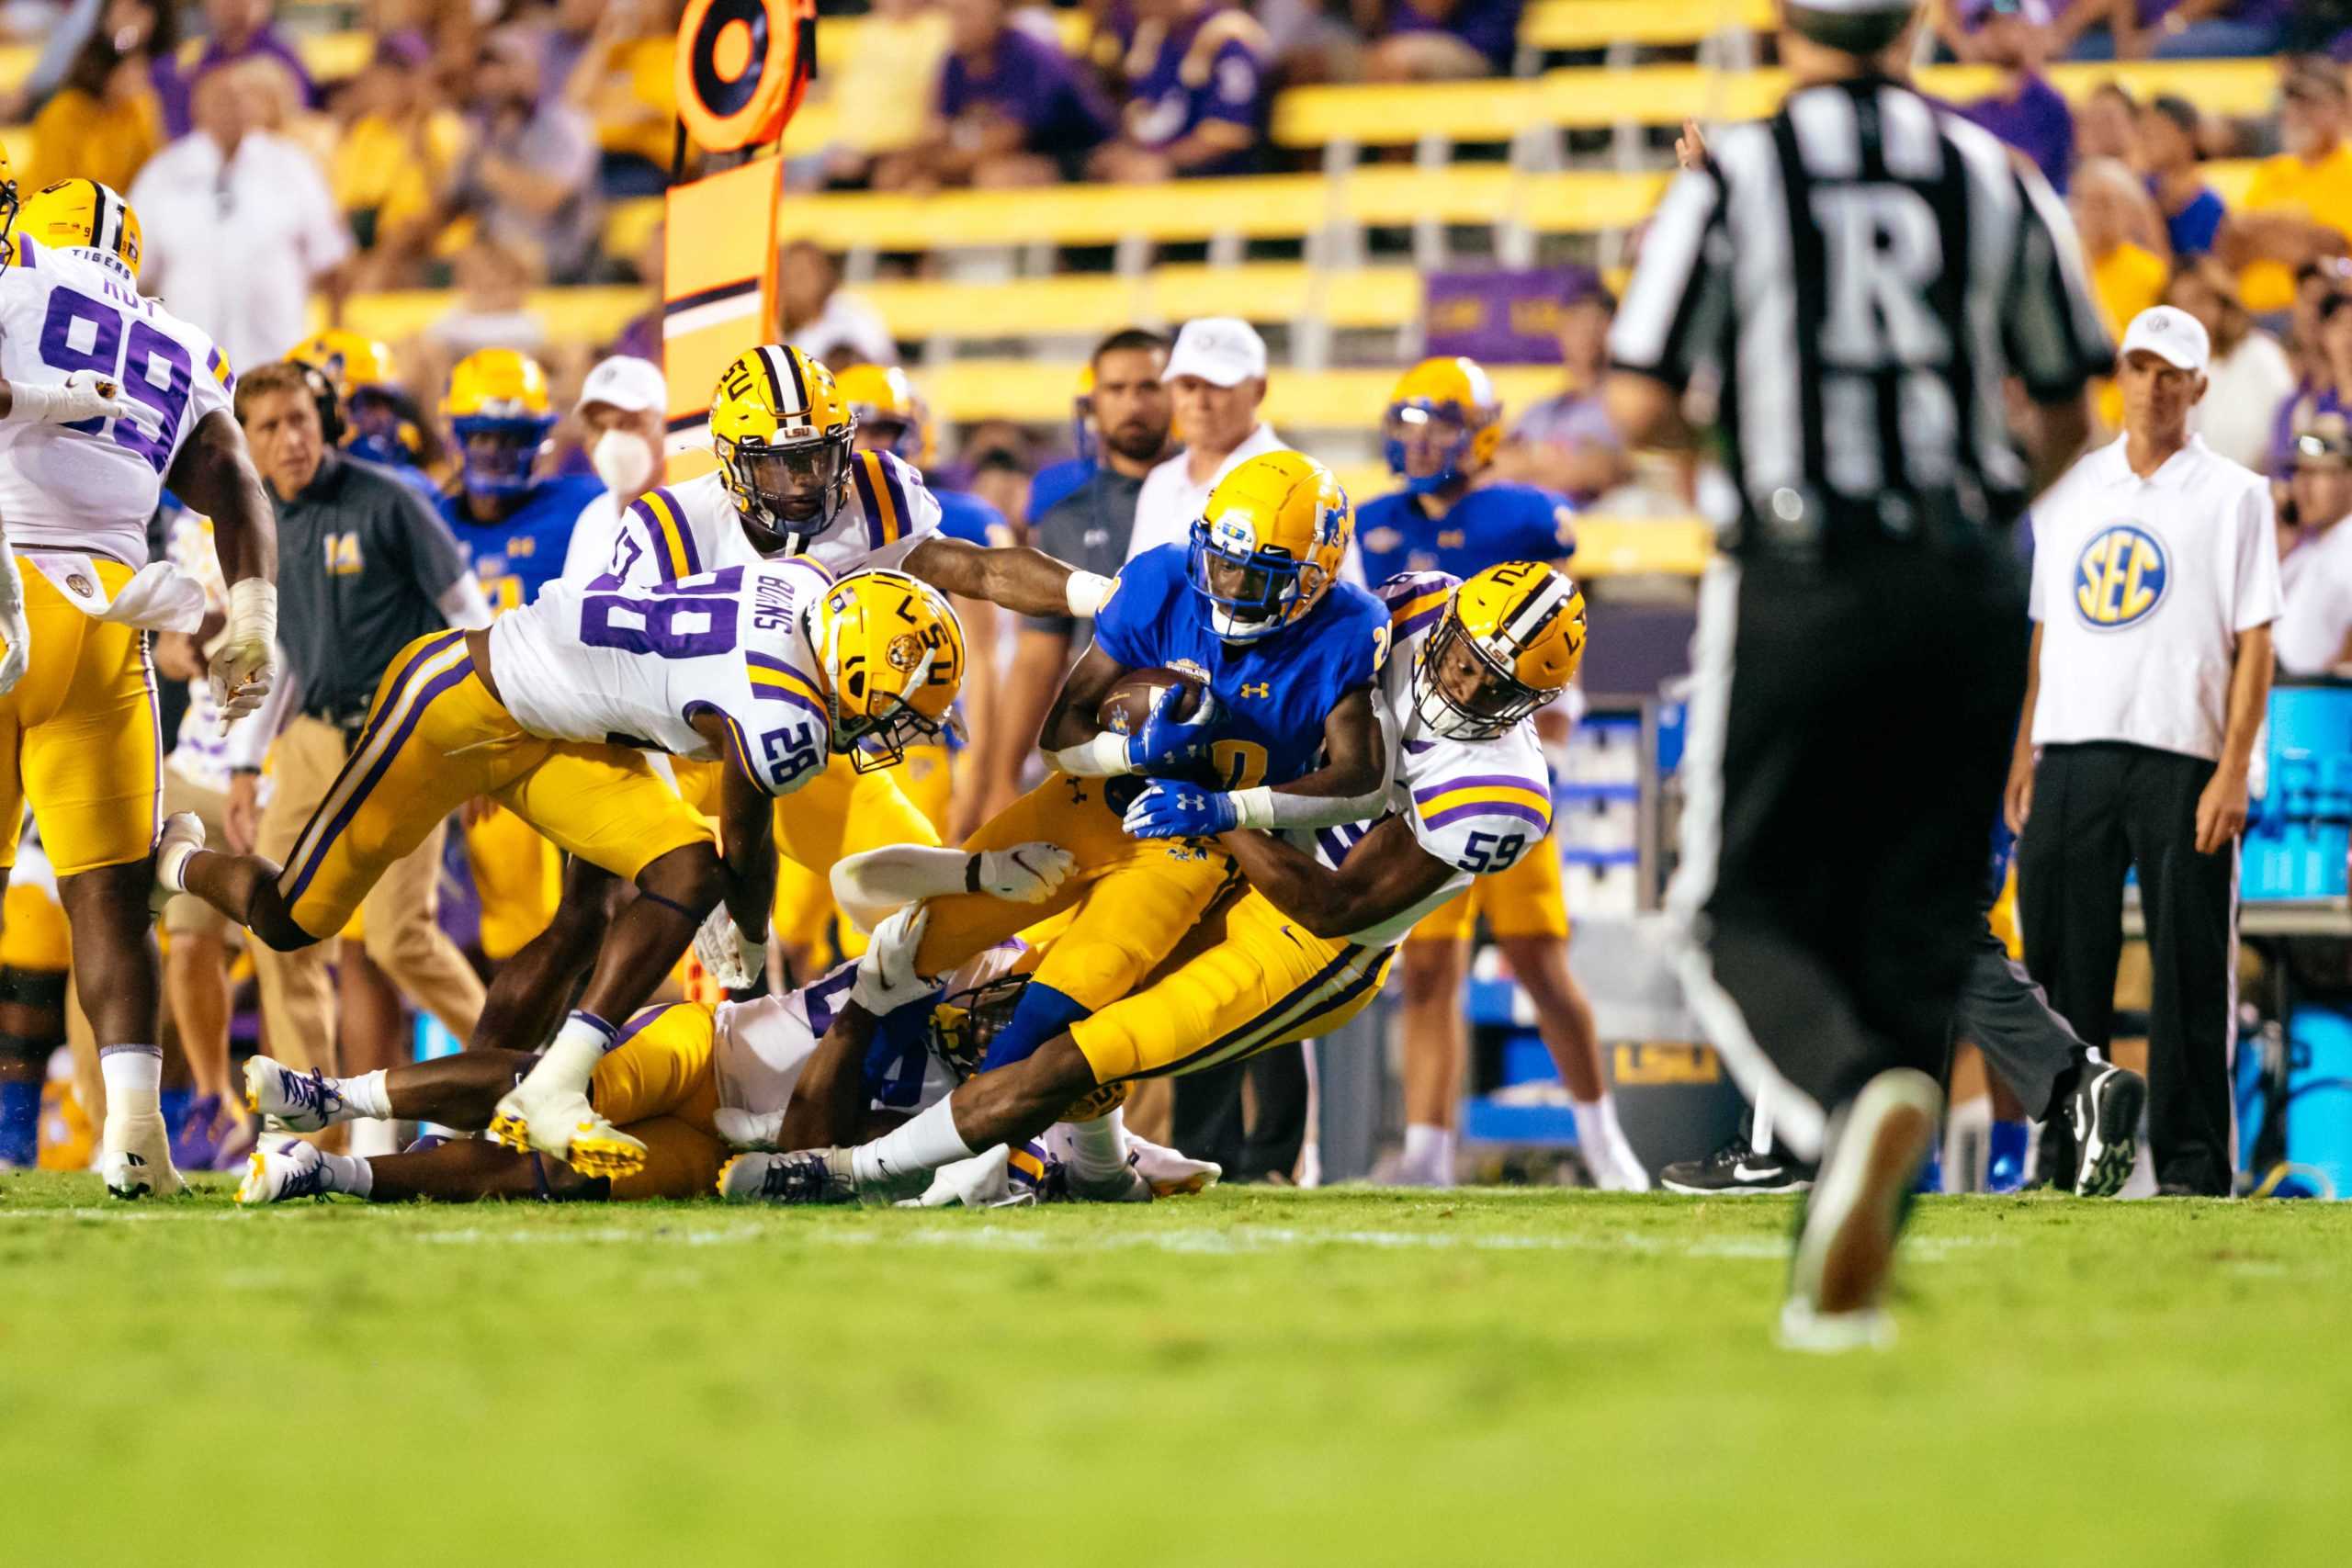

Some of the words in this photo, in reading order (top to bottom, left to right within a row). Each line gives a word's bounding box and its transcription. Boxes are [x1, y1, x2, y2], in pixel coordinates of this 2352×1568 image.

[73, 249, 130, 280] TIGERS
[1809, 185, 1952, 366] R
[784, 426, 810, 439] LSU
[2077, 530, 2160, 623] SEC
[896, 595, 952, 686] LSU
[1486, 644, 1510, 665] LSU
[760, 722, 820, 785] 28
[1458, 830, 1525, 873] 59
